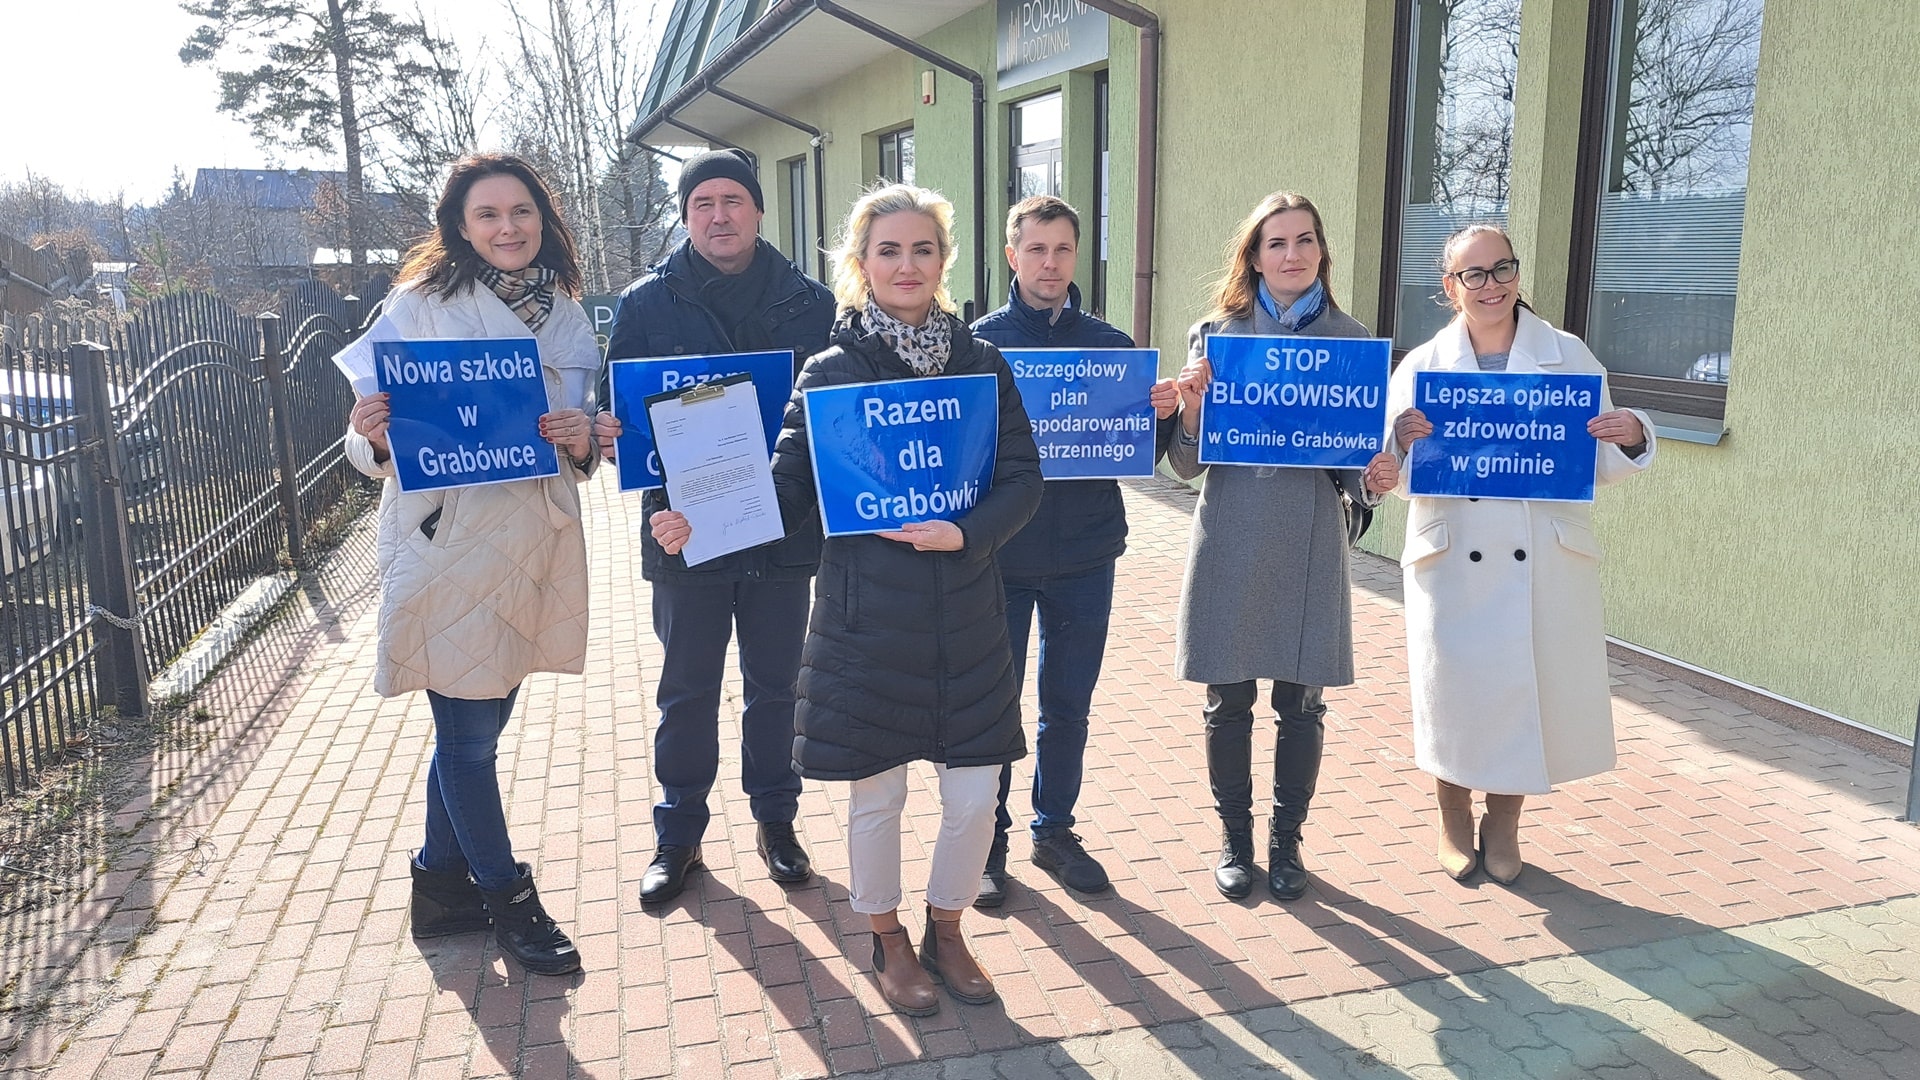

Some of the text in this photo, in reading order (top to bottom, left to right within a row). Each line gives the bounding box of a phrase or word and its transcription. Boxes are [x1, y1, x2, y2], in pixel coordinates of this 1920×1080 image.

[1022, 0, 1094, 38] PORADNI
[1023, 26, 1071, 65] RODZINNA
[382, 354, 454, 385] Nowa
[459, 351, 536, 382] szkoła
[1013, 359, 1127, 382] Szczegółowy
[1265, 347, 1330, 372] STOP
[1051, 388, 1088, 410] plan
[1212, 381, 1379, 409] BLOKOWISKU
[1424, 381, 1591, 411] Lepsza opieka
[457, 405, 478, 427] w
[863, 397, 961, 428] Razem
[1030, 413, 1150, 437] spodarowania
[1207, 428, 1377, 450] w Gminie Grabówka
[1443, 417, 1566, 441] zdrowotna
[418, 442, 536, 477] Grabówce
[898, 440, 943, 471] dla
[1038, 442, 1135, 462] strzennego
[1451, 452, 1555, 479] w gminie
[855, 480, 979, 520] Grabówki
